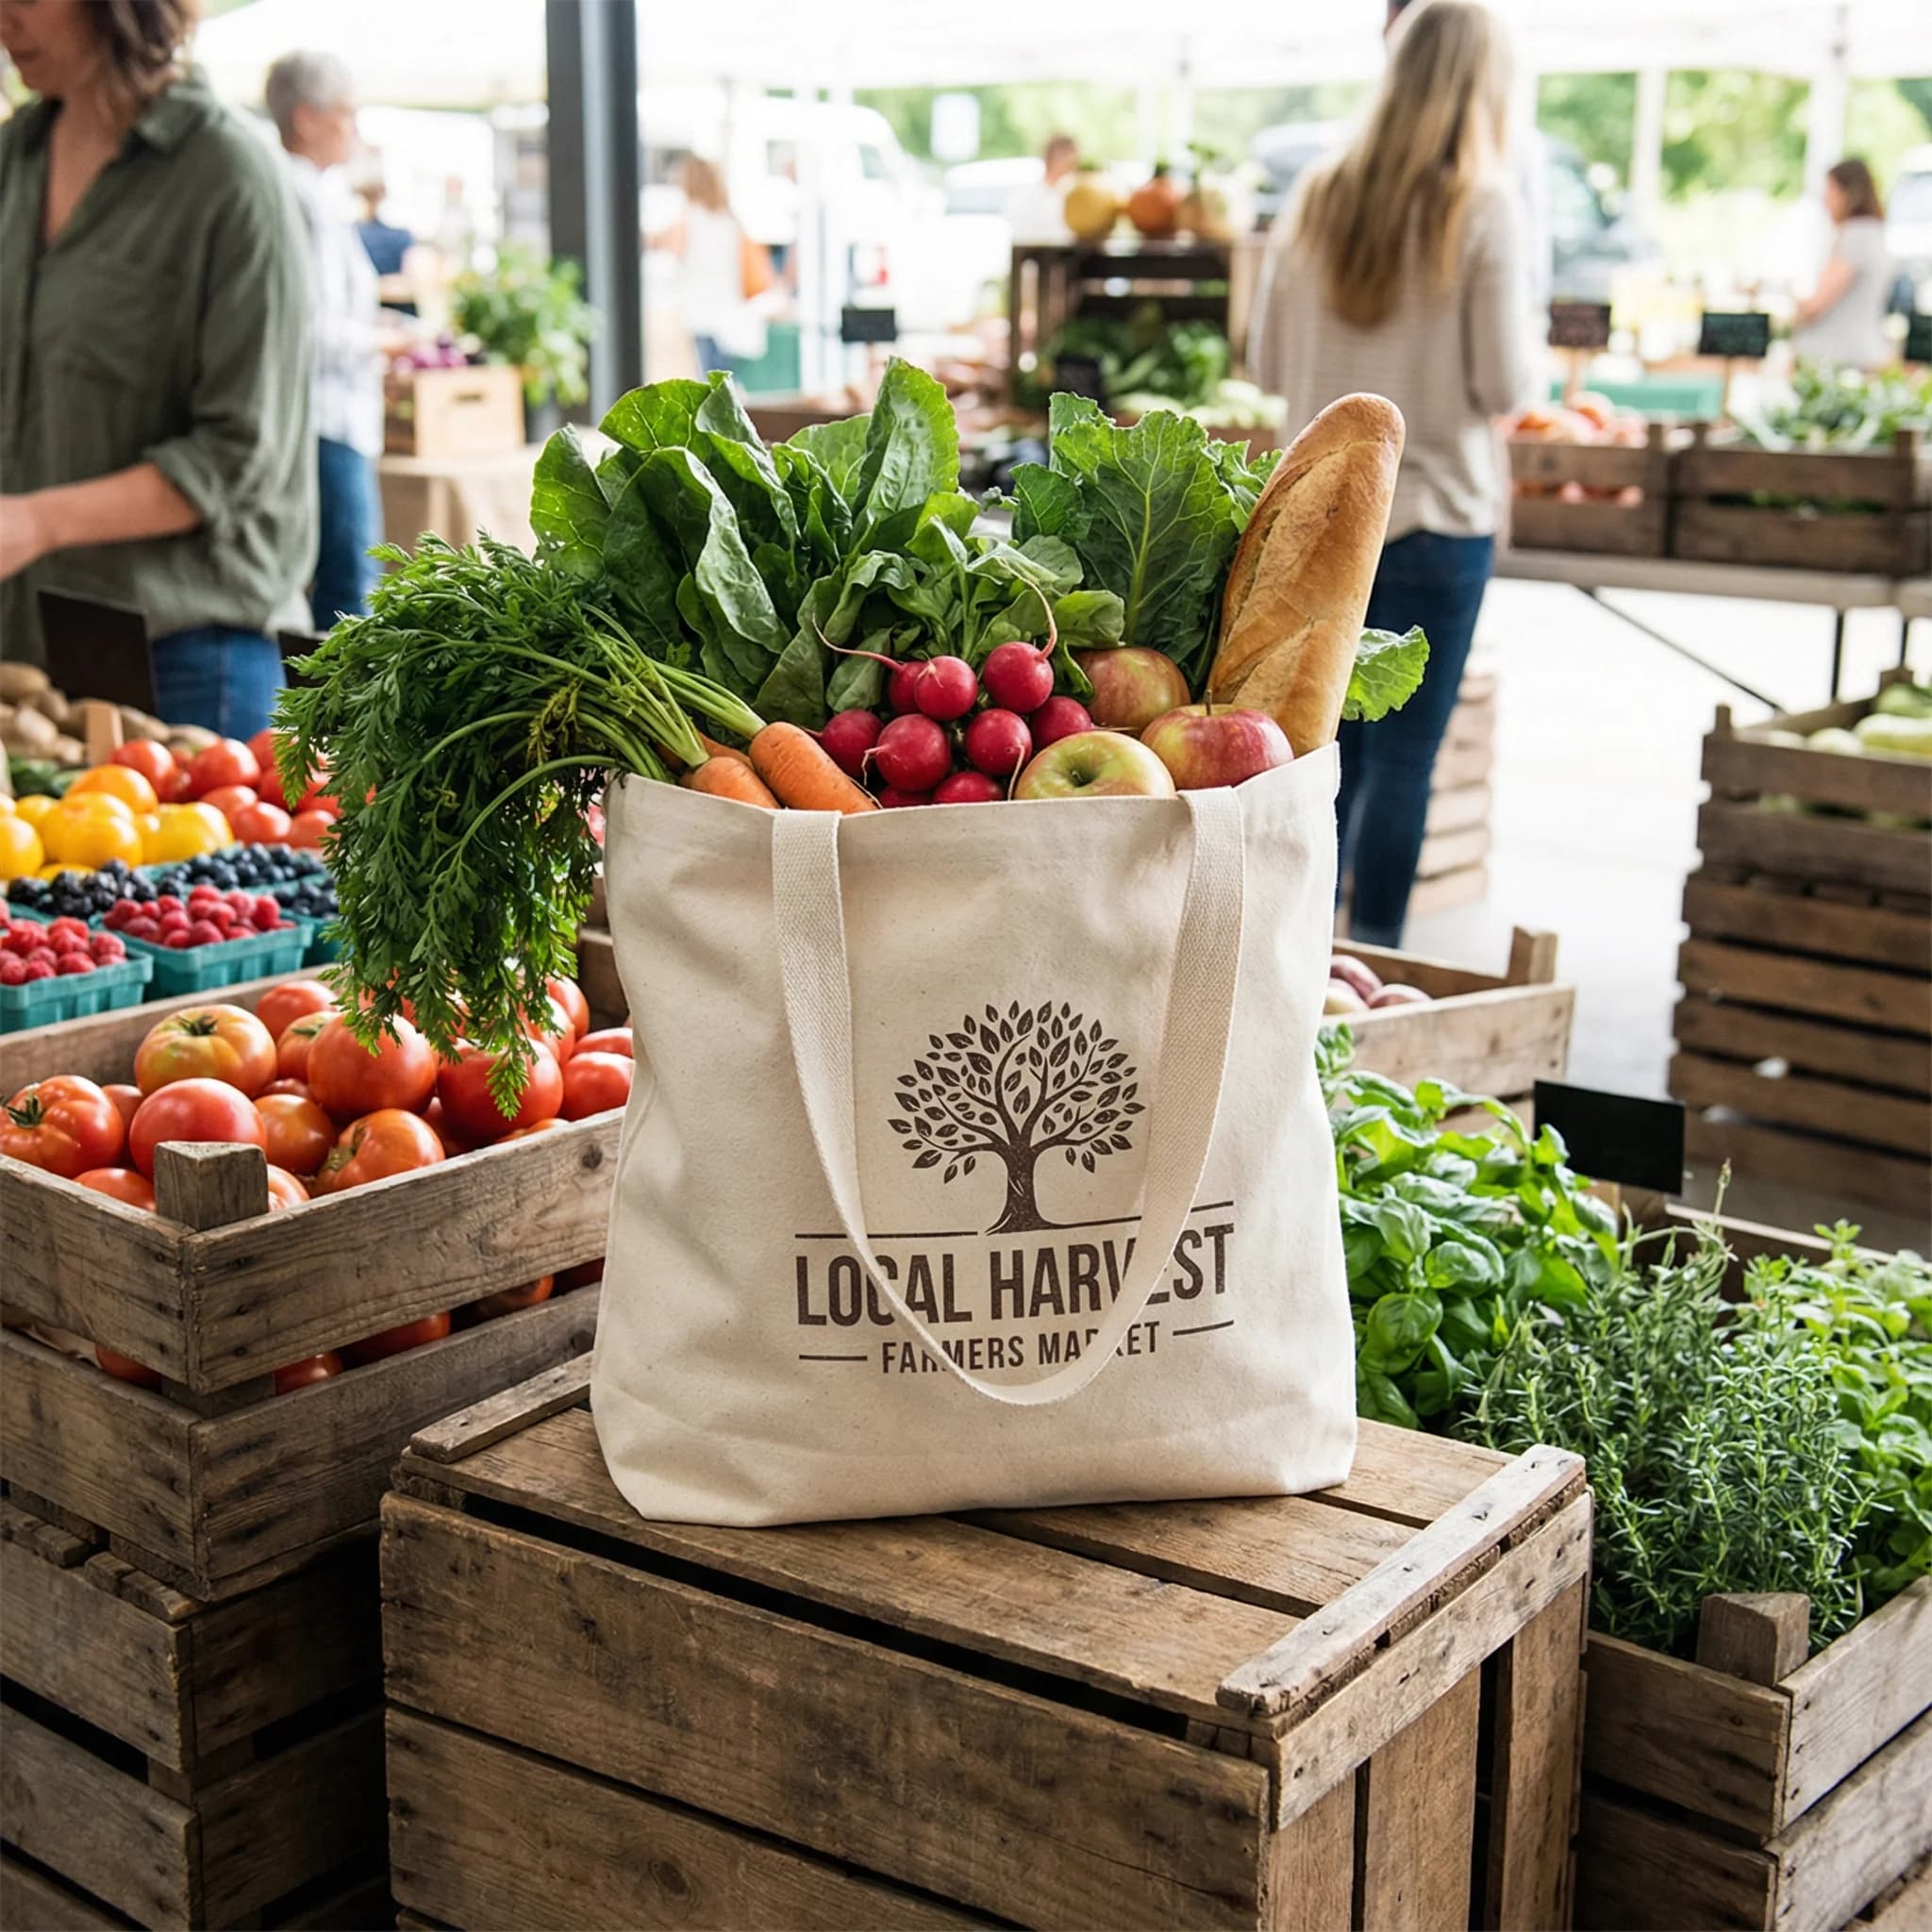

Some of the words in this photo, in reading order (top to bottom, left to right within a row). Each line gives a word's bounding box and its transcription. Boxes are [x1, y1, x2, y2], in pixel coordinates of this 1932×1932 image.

[796, 1254, 973, 1326] LOCAL
[990, 1223, 1234, 1321] HARVST
[1038, 1321, 1160, 1365] MAET
